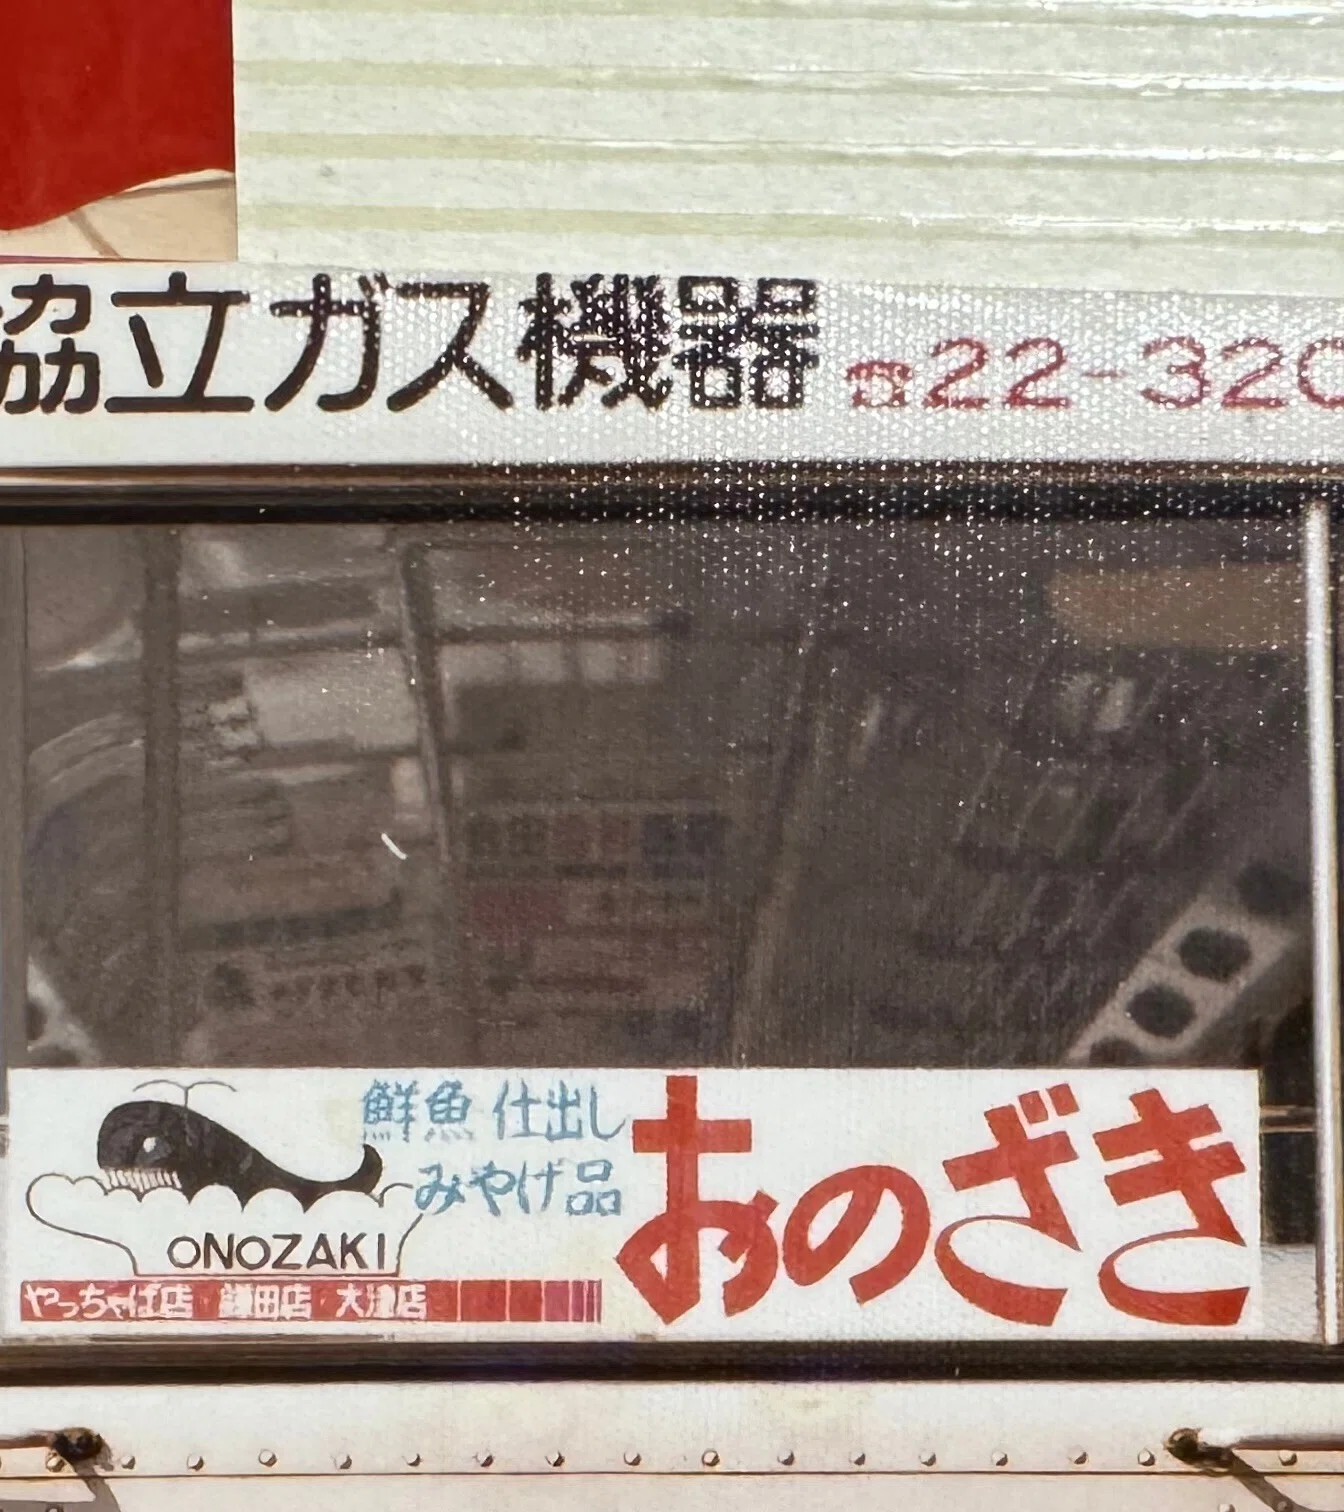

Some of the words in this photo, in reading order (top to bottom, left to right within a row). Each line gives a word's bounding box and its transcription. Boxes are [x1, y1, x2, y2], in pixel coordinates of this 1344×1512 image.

[361, 1078, 474, 1143] 鮮魚
[493, 1078, 626, 1142] 仕出し
[414, 1157, 622, 1217] みやげ品
[616, 1075, 1250, 1327] おのざき
[167, 1232, 385, 1270] ONOZAKI
